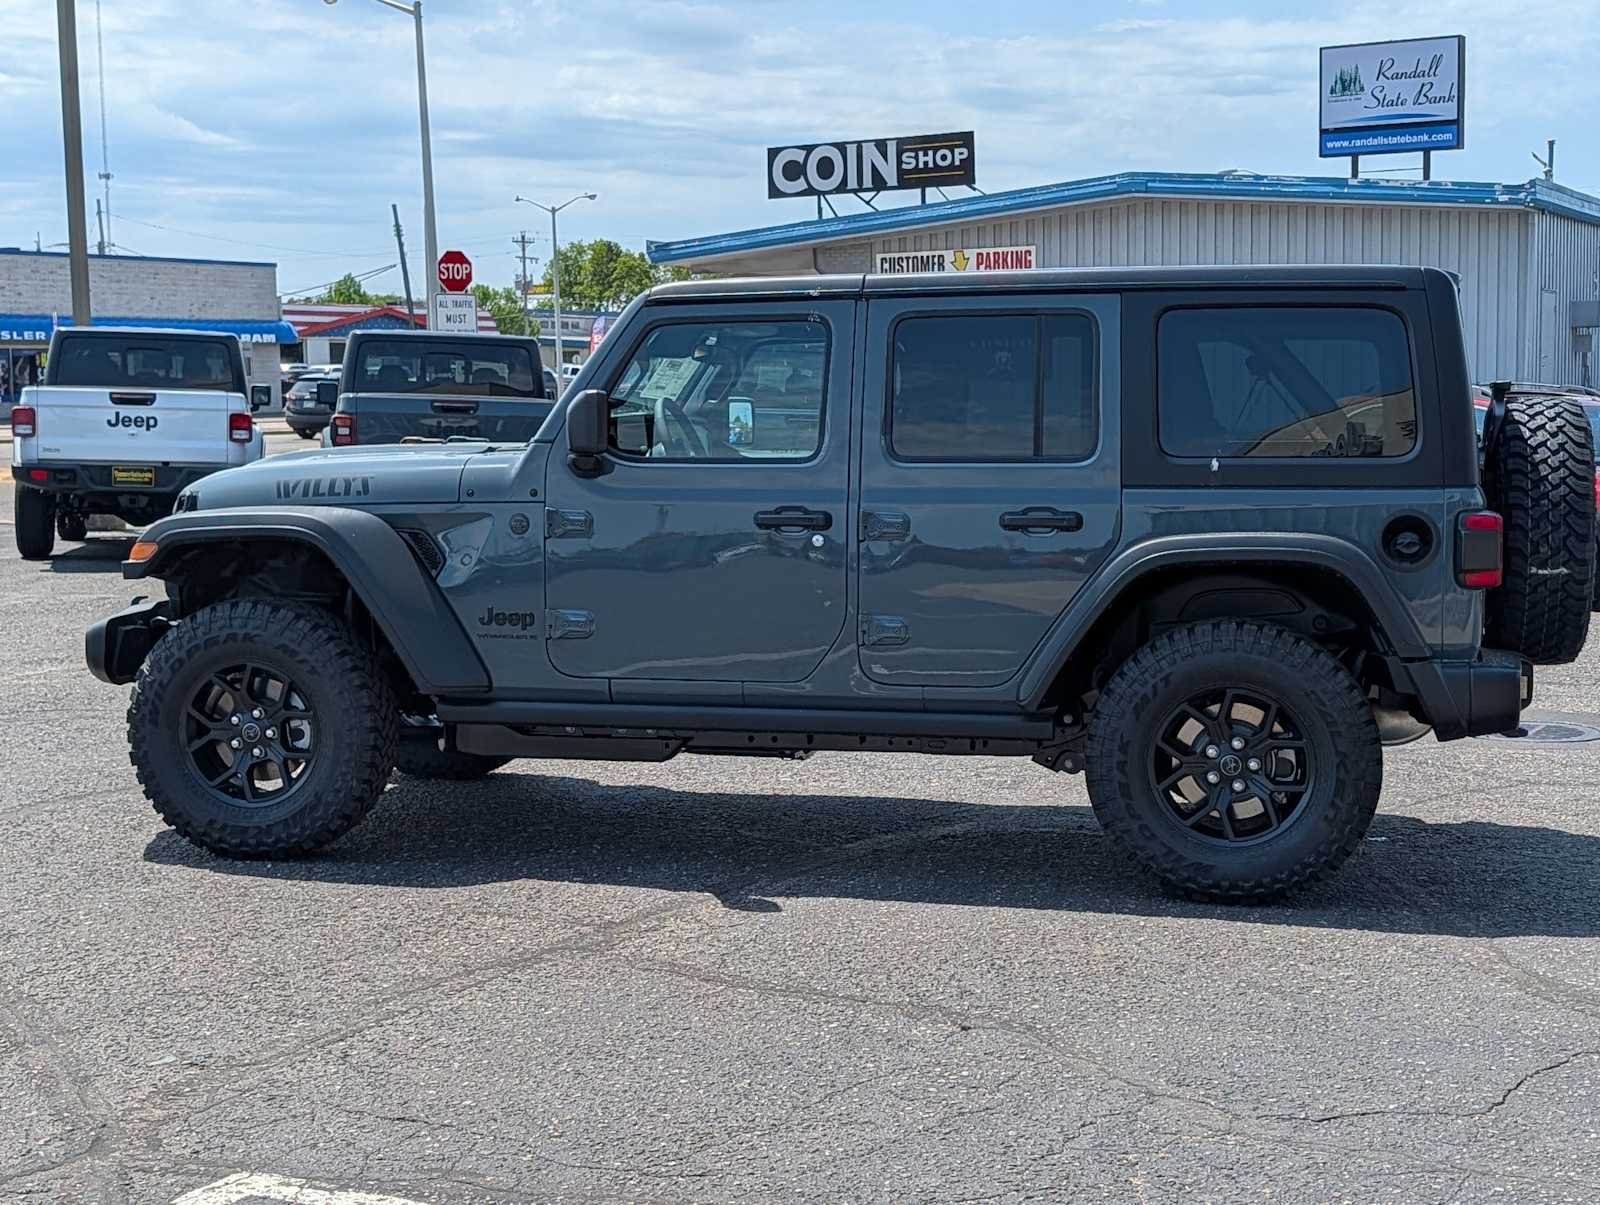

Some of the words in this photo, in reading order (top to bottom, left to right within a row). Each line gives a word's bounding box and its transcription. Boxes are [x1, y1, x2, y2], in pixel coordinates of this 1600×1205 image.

[1376, 54, 1444, 81] Randall
[1364, 86, 1407, 109] State
[1413, 82, 1455, 106] Bank
[1326, 132, 1453, 149] www.randallstatebank.com
[772, 140, 899, 194] COIN
[901, 147, 969, 170] SHOP
[439, 263, 471, 280] STOP
[880, 254, 946, 274] CUSTOMER
[976, 250, 1033, 271] PARKING
[438, 299, 448, 309] ALL
[452, 299, 473, 309] TRAFFIC
[446, 314, 467, 324] MUST
[240, 333, 277, 344] RAM
[107, 411, 158, 432] Jeep
[276, 476, 376, 499] WILLYS
[478, 607, 535, 631] Jeep
